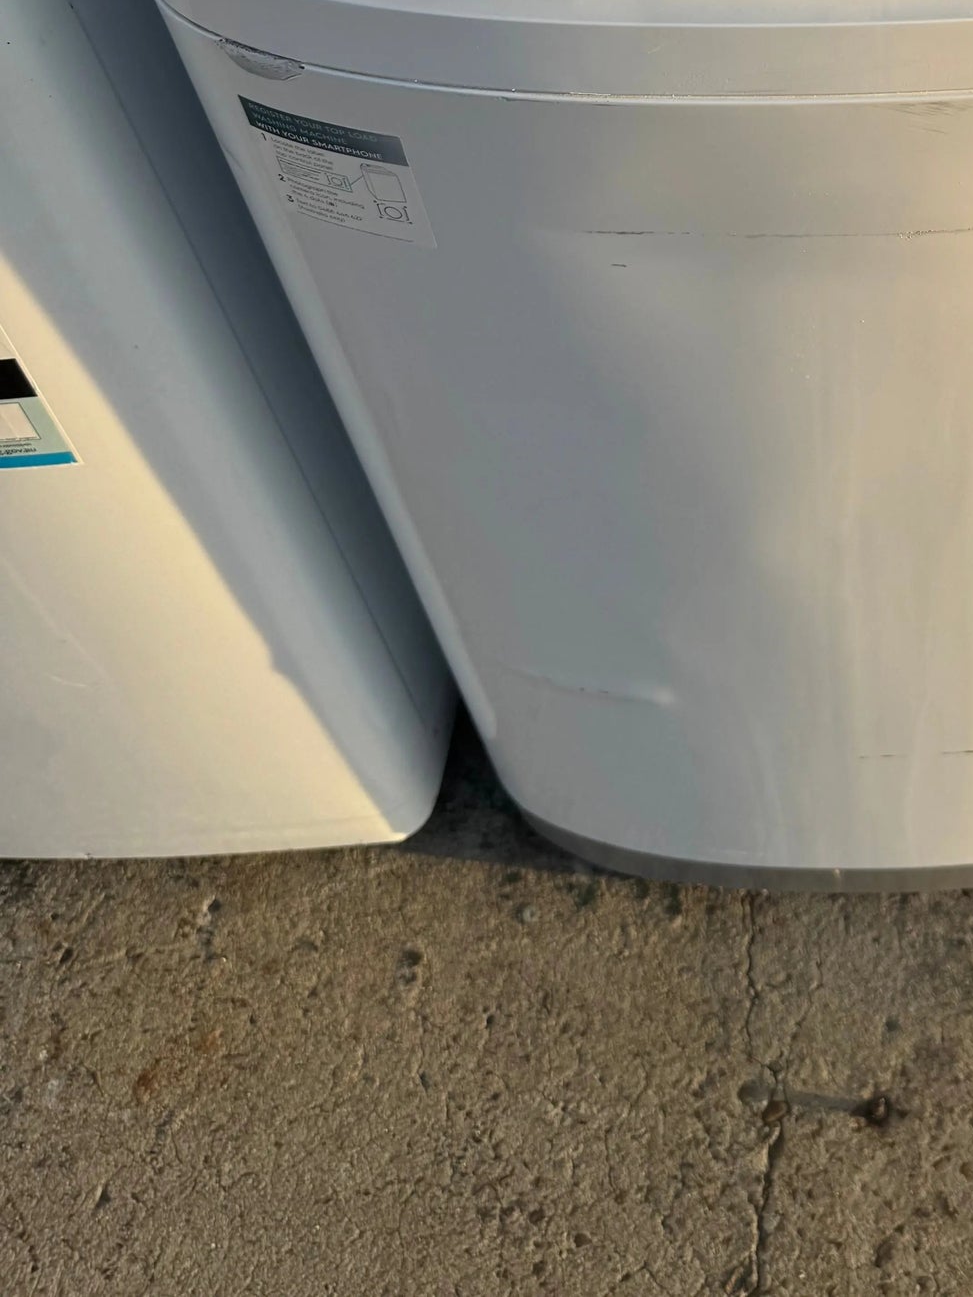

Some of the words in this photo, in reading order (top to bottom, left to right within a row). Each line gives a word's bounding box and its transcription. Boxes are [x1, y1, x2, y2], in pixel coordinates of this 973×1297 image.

[255, 120, 280, 135] WITH
[281, 132, 310, 144] YOUR
[312, 139, 384, 160] SMARTPHONE
[295, 118, 323, 130] YOUR
[325, 126, 345, 135] TOP
